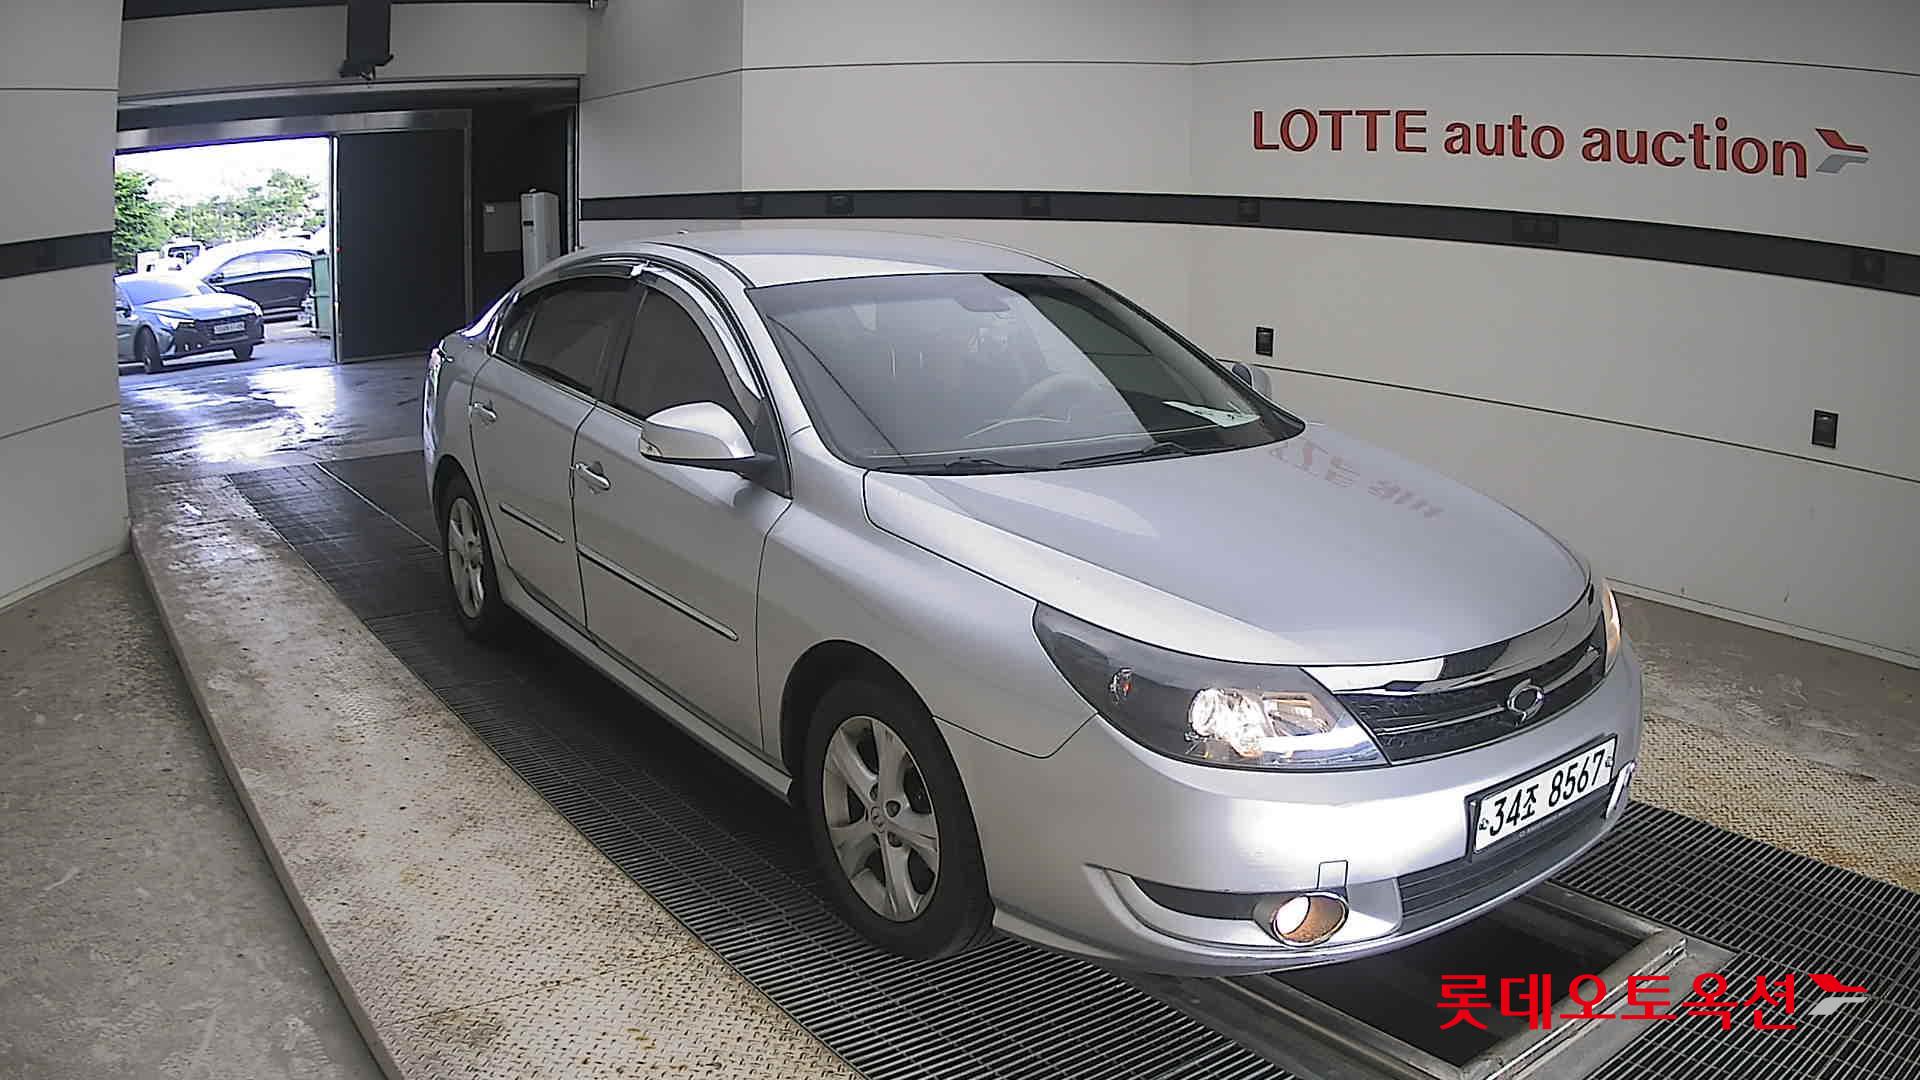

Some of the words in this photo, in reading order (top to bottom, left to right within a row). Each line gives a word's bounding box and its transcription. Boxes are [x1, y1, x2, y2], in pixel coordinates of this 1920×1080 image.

[1252, 108, 1428, 154] LOTTE
[1443, 114, 1565, 160] auto
[1581, 117, 1809, 179] auction
[1489, 783, 1539, 836] 34조
[1548, 748, 1606, 808] 8567
